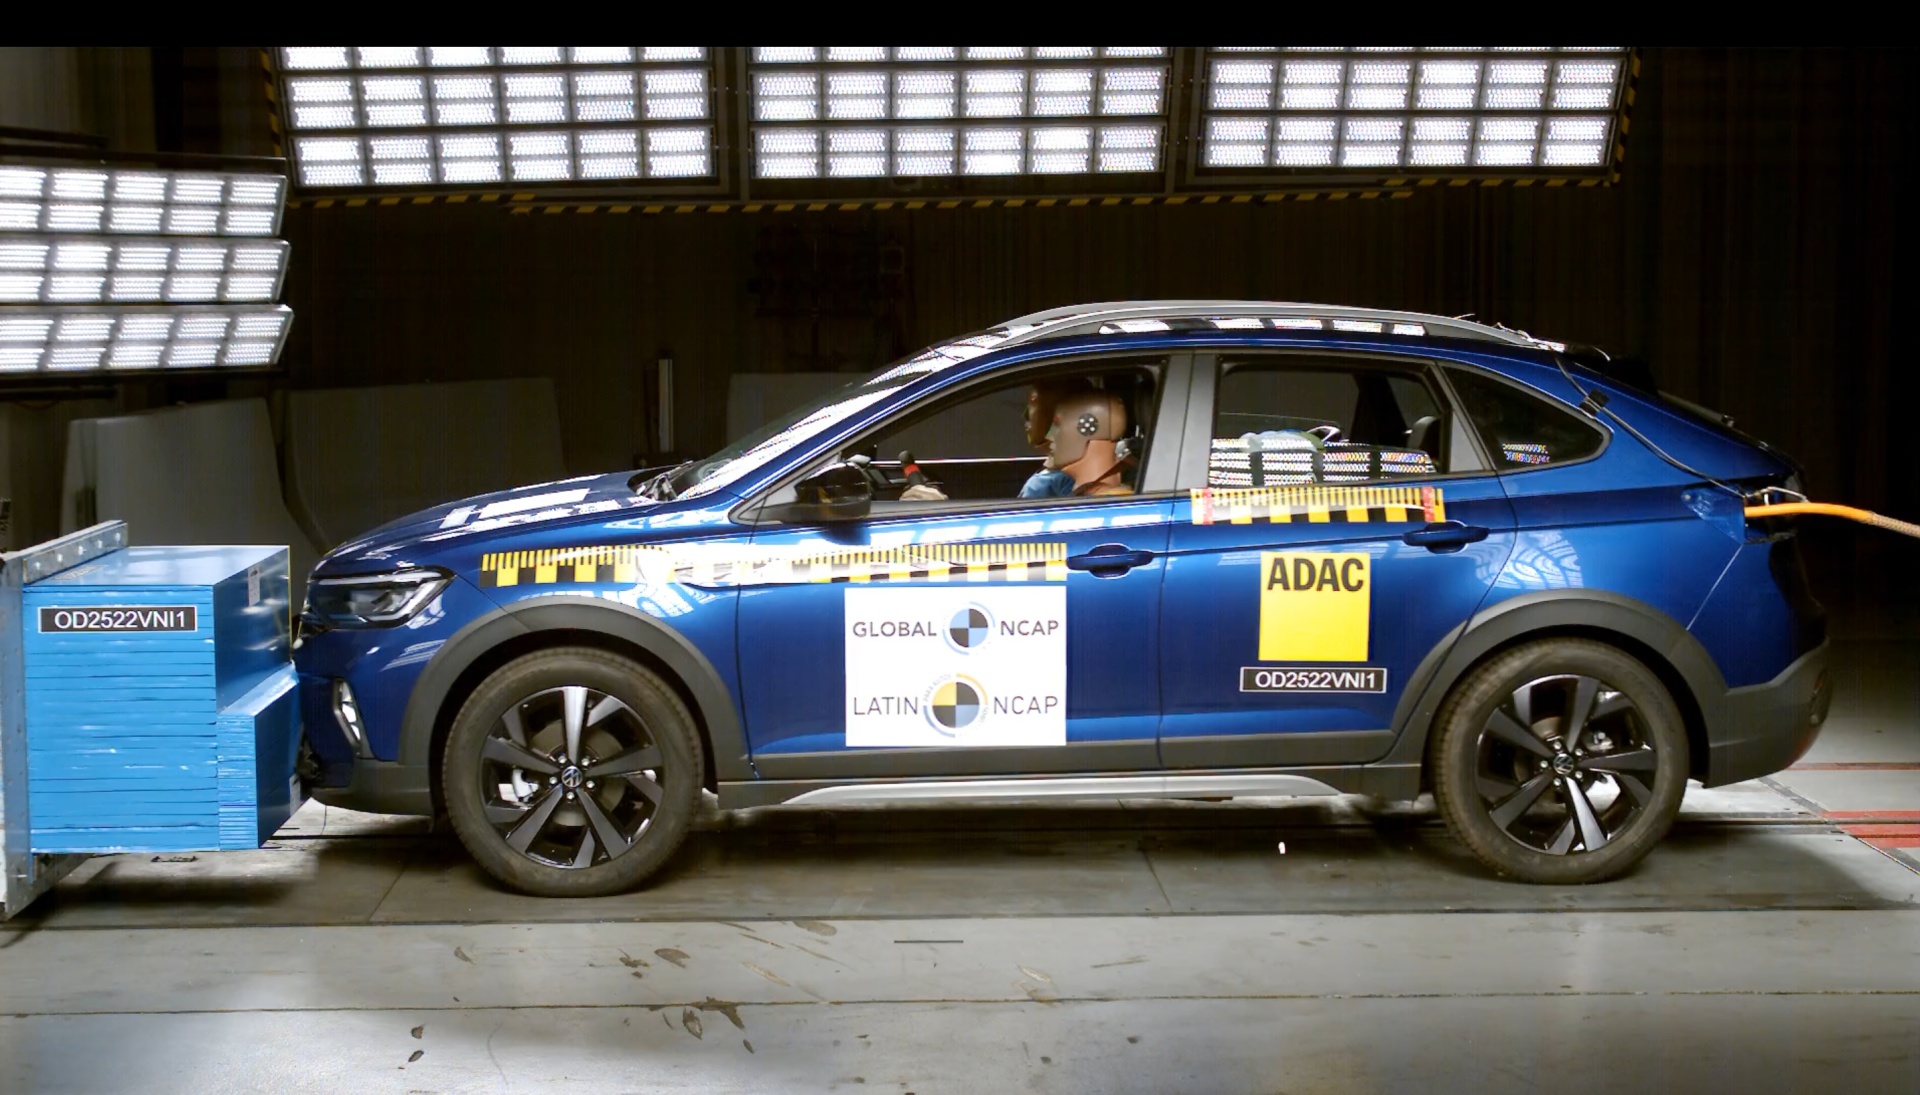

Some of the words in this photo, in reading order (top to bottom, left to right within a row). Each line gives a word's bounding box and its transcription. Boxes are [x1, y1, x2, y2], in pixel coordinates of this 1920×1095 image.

[1267, 557, 1364, 591] ADAC
[54, 610, 185, 629] OD2522VNI1
[852, 620, 938, 637] GLOBAL
[1000, 620, 1059, 636] NCAP
[1254, 671, 1375, 689] OD2522VNI1
[853, 697, 918, 715] LATIN
[993, 696, 1059, 714] NCAP
